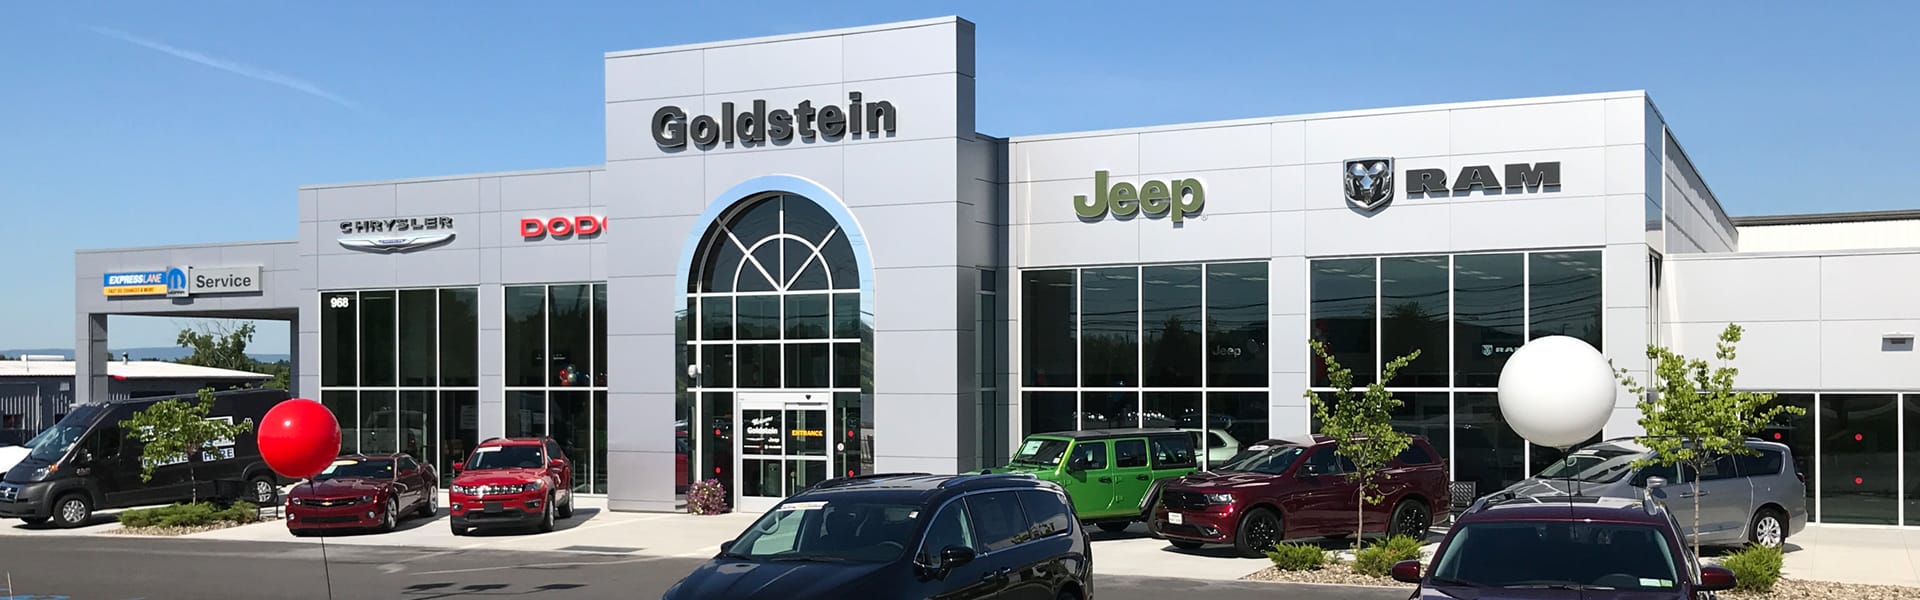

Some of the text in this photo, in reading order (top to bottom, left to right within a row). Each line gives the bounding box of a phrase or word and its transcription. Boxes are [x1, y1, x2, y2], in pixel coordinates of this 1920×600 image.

[651, 91, 896, 151] Goldstein
[1405, 161, 1561, 199] RAM
[1073, 170, 1205, 226] Jeep
[339, 216, 454, 234] CHRYSLER
[520, 215, 607, 240] DOD
[196, 275, 251, 289] Service
[330, 297, 349, 308] 968
[1212, 344, 1241, 358] Jeep
